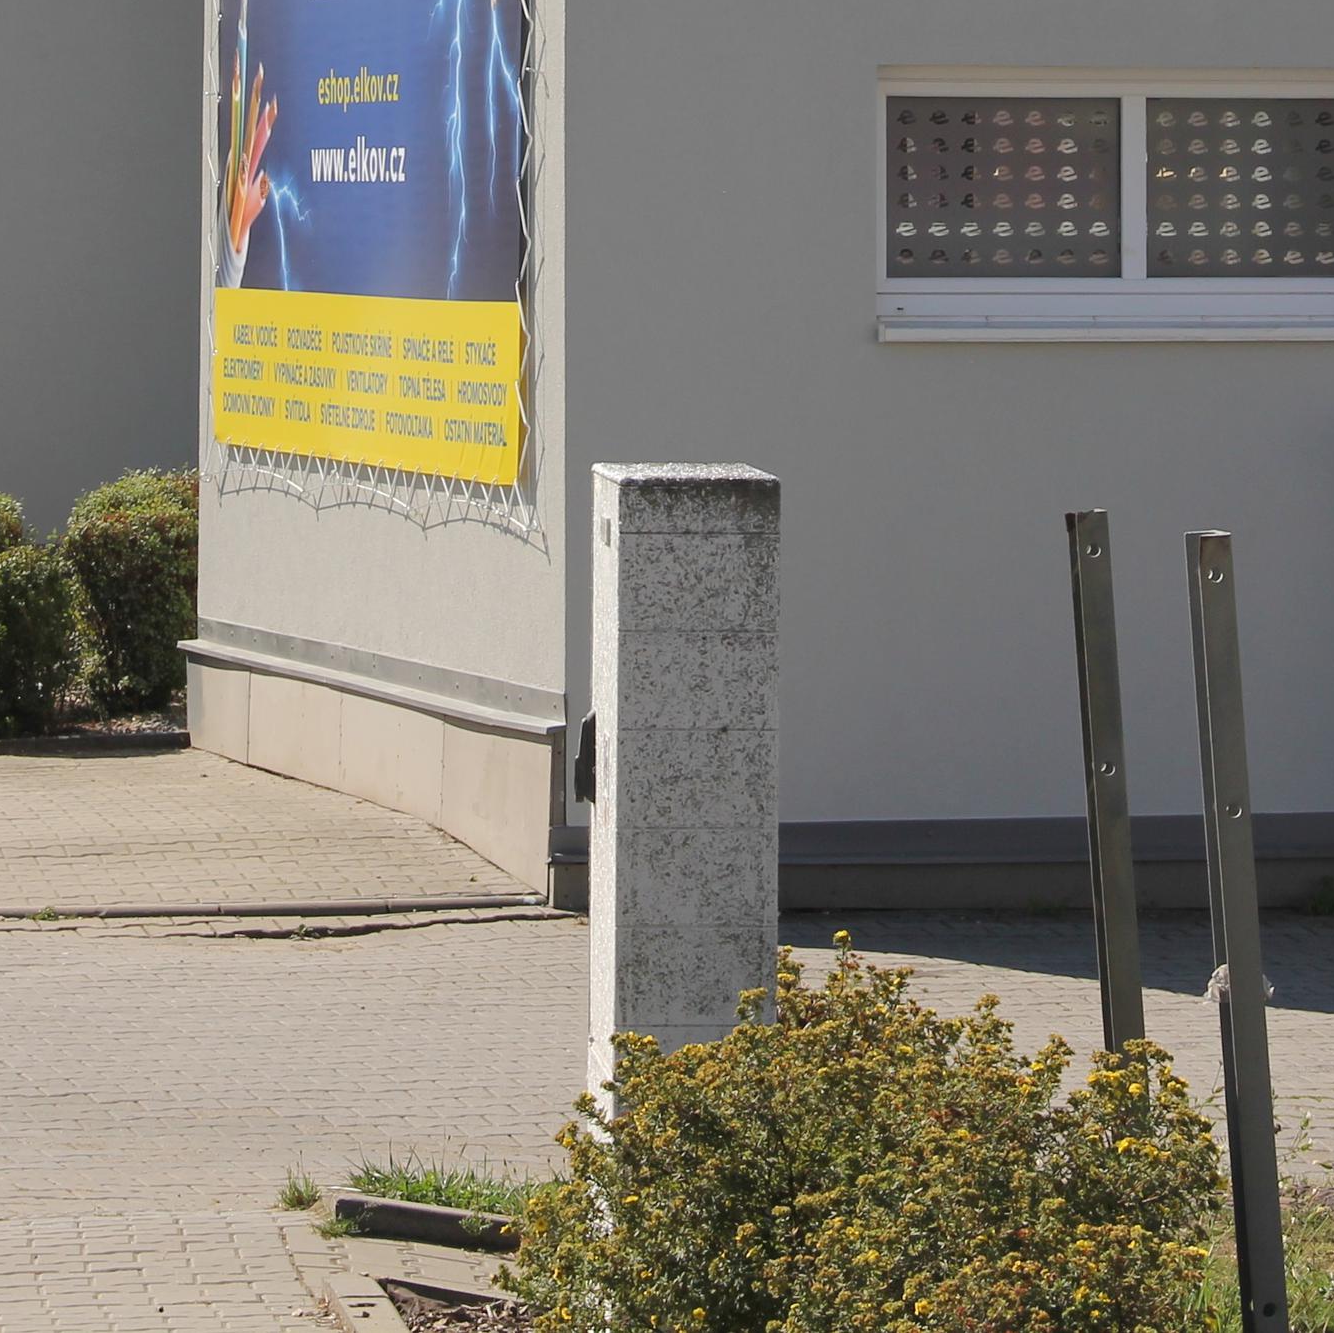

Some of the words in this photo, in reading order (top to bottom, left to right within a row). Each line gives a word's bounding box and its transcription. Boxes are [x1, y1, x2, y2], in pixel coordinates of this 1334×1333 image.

[317, 66, 400, 113] eshop.elkov.cz
[311, 135, 406, 183] www.elkov.cz
[256, 321, 278, 348] VODIČE
[287, 324, 322, 352] ROZVADĚČE
[332, 328, 369, 357] POJISTKOVÉ
[403, 332, 430, 361] SPÍNAČE
[438, 334, 454, 364] RELÉ
[465, 336, 496, 366] STYKAČE
[223, 355, 264, 381] ELEKTROMĚRY
[274, 357, 303, 386] VYPÍNAČE
[309, 361, 337, 389] ZÁSUVKY
[347, 367, 388, 395] VENTILÁTORY
[399, 370, 421, 398] TOPNÁ
[422, 371, 446, 402] TĚLESA
[457, 381, 507, 407] HROMOSVODY
[223, 389, 251, 413] DOMOVNÍ
[251, 395, 276, 417] ZVONKY
[285, 394, 311, 423] SVÍTIDLA
[320, 398, 351, 428] SVĚTELNÉ
[351, 406, 375, 432] ZDROJE
[385, 411, 434, 439] FOTOVOLTAIKA
[444, 415, 473, 444] OSTATNÍ
[473, 417, 508, 447] MATERIÁL
